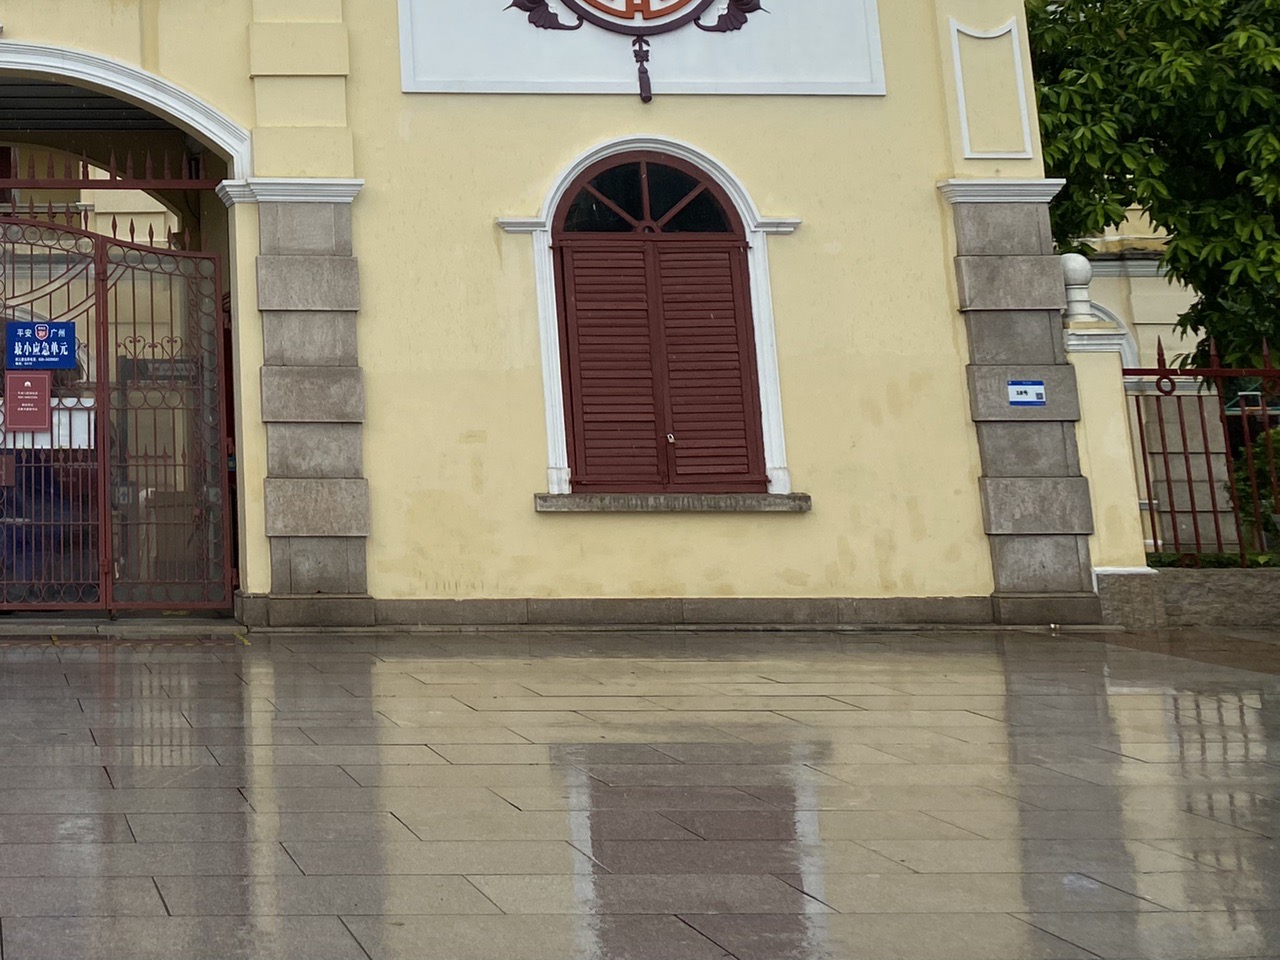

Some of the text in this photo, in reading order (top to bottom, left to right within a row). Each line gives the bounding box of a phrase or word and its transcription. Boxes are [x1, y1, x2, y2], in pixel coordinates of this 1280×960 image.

[16, 328, 32, 338] 平安
[50, 328, 66, 338] 广州
[14, 341, 68, 356] 最小应急单元
